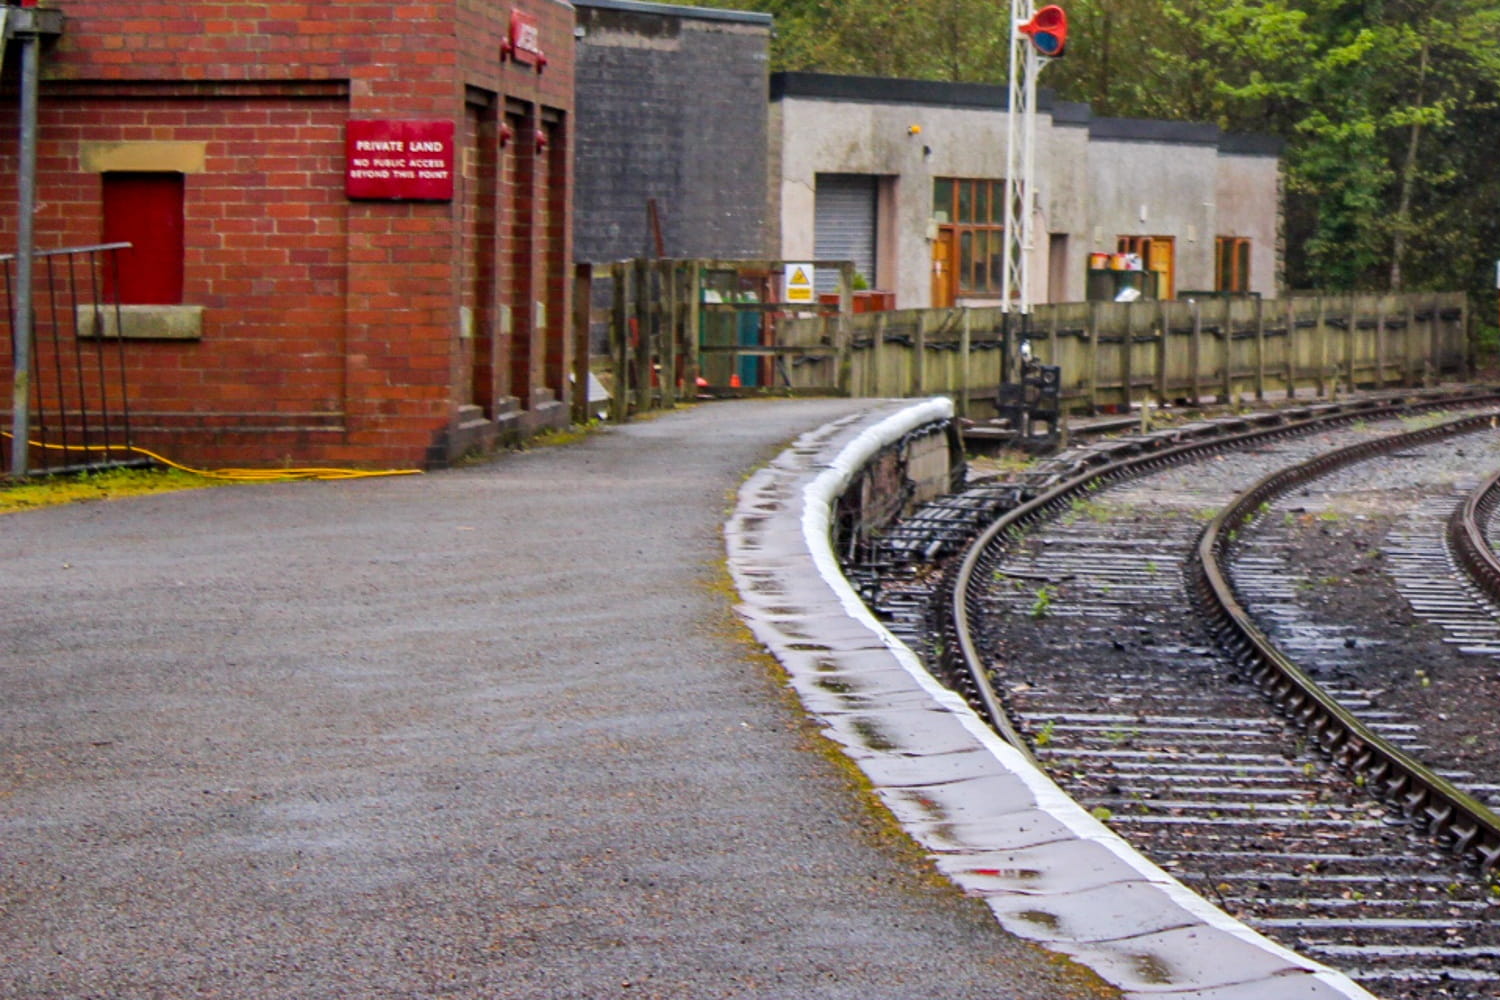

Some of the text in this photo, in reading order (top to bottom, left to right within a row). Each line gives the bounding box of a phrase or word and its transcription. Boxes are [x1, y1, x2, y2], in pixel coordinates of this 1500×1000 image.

[356, 140, 444, 153] PRIVATE LAND
[353, 159, 445, 168] NO PUBLIC ACCESS
[350, 170, 449, 179] BEYOND THIS POINT
